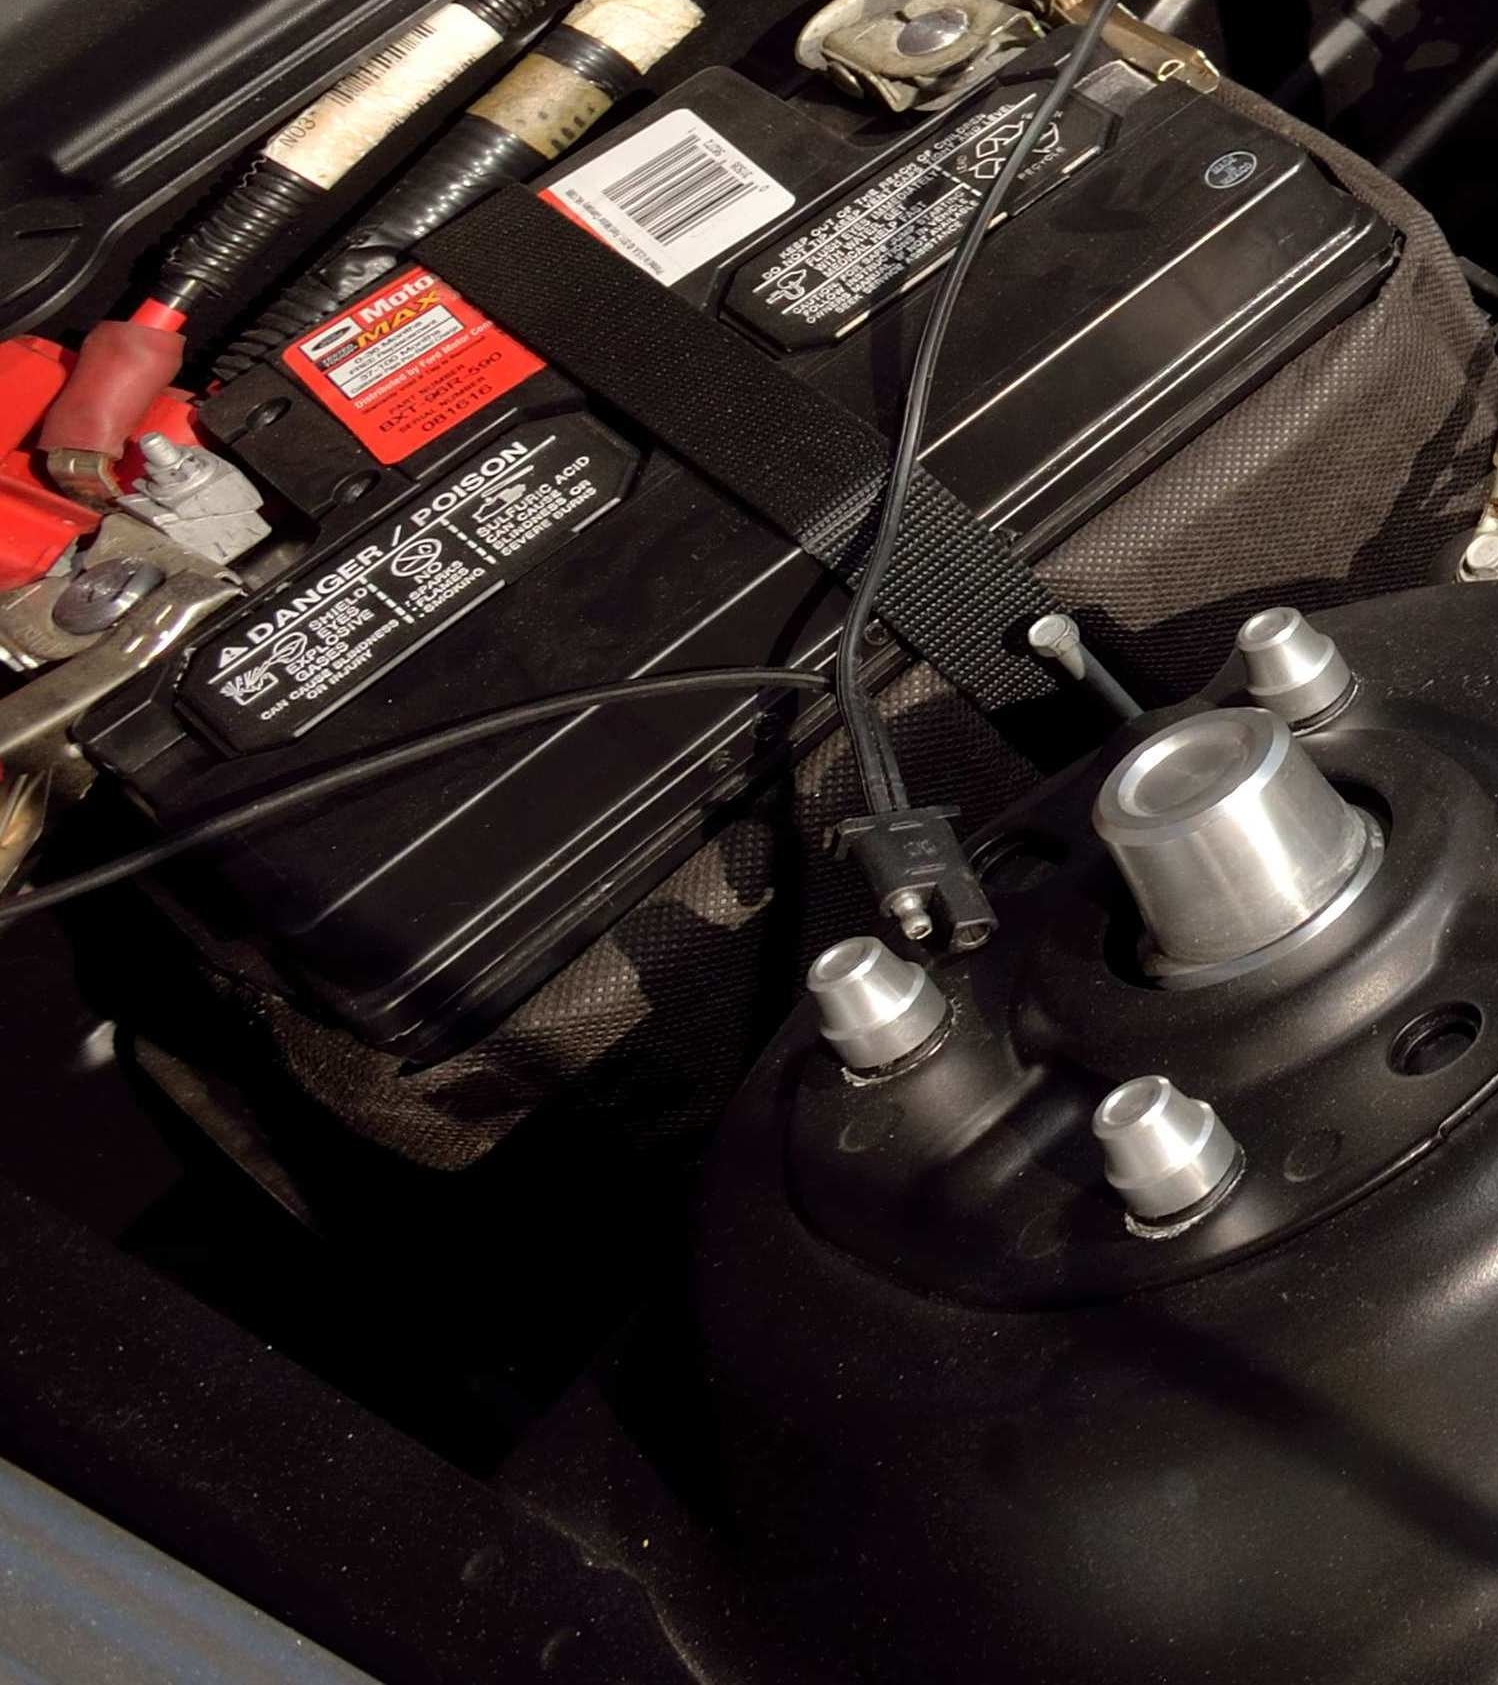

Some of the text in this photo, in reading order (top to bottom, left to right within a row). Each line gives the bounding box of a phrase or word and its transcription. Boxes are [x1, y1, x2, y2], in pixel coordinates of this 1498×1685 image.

[776, 234, 811, 259] KEEP
[809, 216, 837, 237] OUT
[835, 204, 856, 219] OF
[853, 186, 880, 206] THE
[803, 168, 944, 267] FLUSH EYES IMMEDIATELY
[814, 246, 850, 272] WITH
[883, 203, 909, 222] GET
[820, 199, 931, 278] MEDICAL HELP FAST
[760, 264, 783, 281] DO
[781, 246, 810, 267] NOT
[350, 291, 443, 348] MAX
[351, 372, 409, 409] Distributed
[417, 350, 444, 368] Ford
[439, 333, 471, 353] Motor
[475, 452, 594, 539] SULFURIC ACID
[483, 487, 563, 546] CAN CAUSE
[490, 476, 594, 552] BLINDNESS OR
[498, 484, 599, 558] SEVERE BURNS
[245, 541, 386, 646] DANGER
[409, 438, 529, 528] POISON
[411, 558, 446, 586] NO
[283, 607, 377, 676] EXPLOSIVE
[306, 583, 371, 633] SHIELD
[314, 603, 362, 640] EYES
[258, 617, 402, 722] CAN CAUSE BLINDNESS
[292, 639, 352, 684] GASES
[304, 648, 376, 702] OR INJURY
